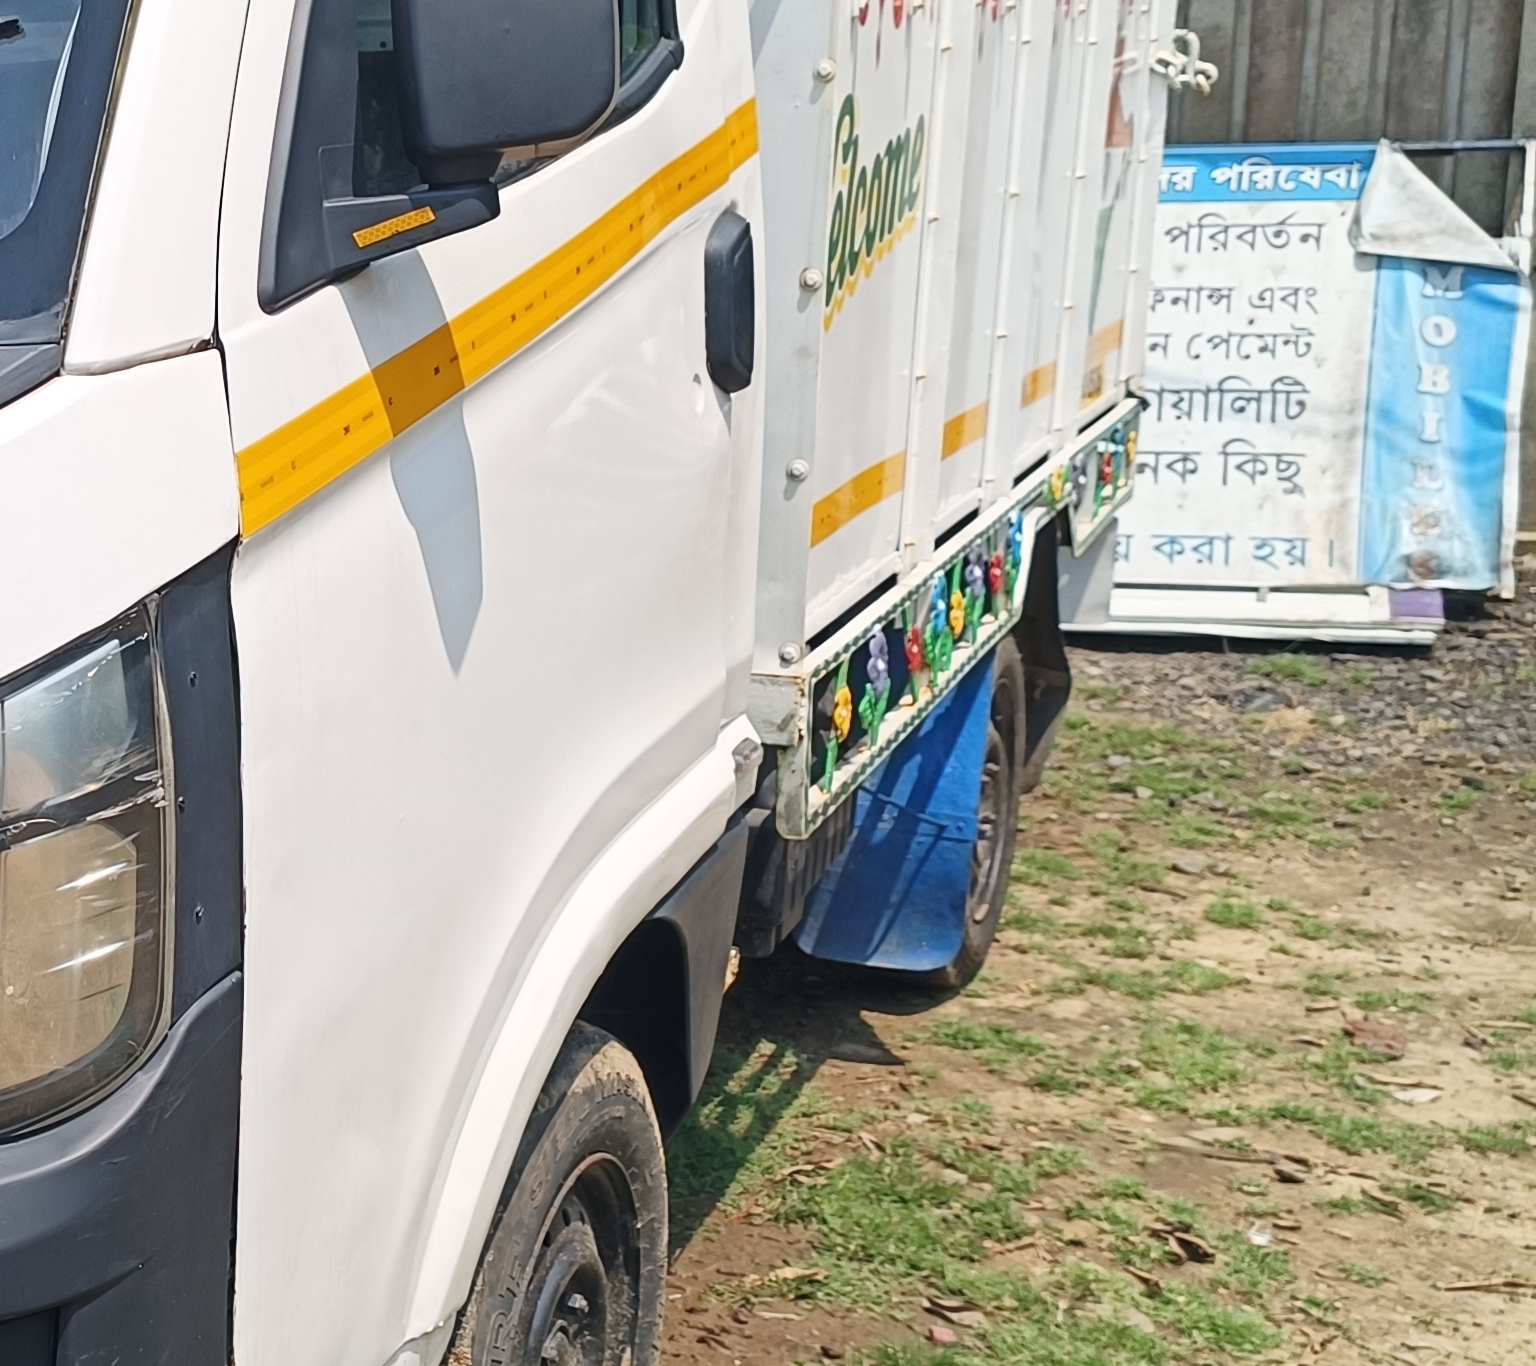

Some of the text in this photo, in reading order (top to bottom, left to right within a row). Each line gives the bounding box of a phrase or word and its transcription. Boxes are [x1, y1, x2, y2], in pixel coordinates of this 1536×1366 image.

[1210, 155, 1364, 193] পরিষেবা
[1164, 211, 1327, 254] পরিবর্তন
[1248, 286, 1319, 315] এবং
[1217, 437, 1306, 498] কিছু
[1150, 532, 1234, 567] করা
[1248, 534, 1310, 571] হয়
